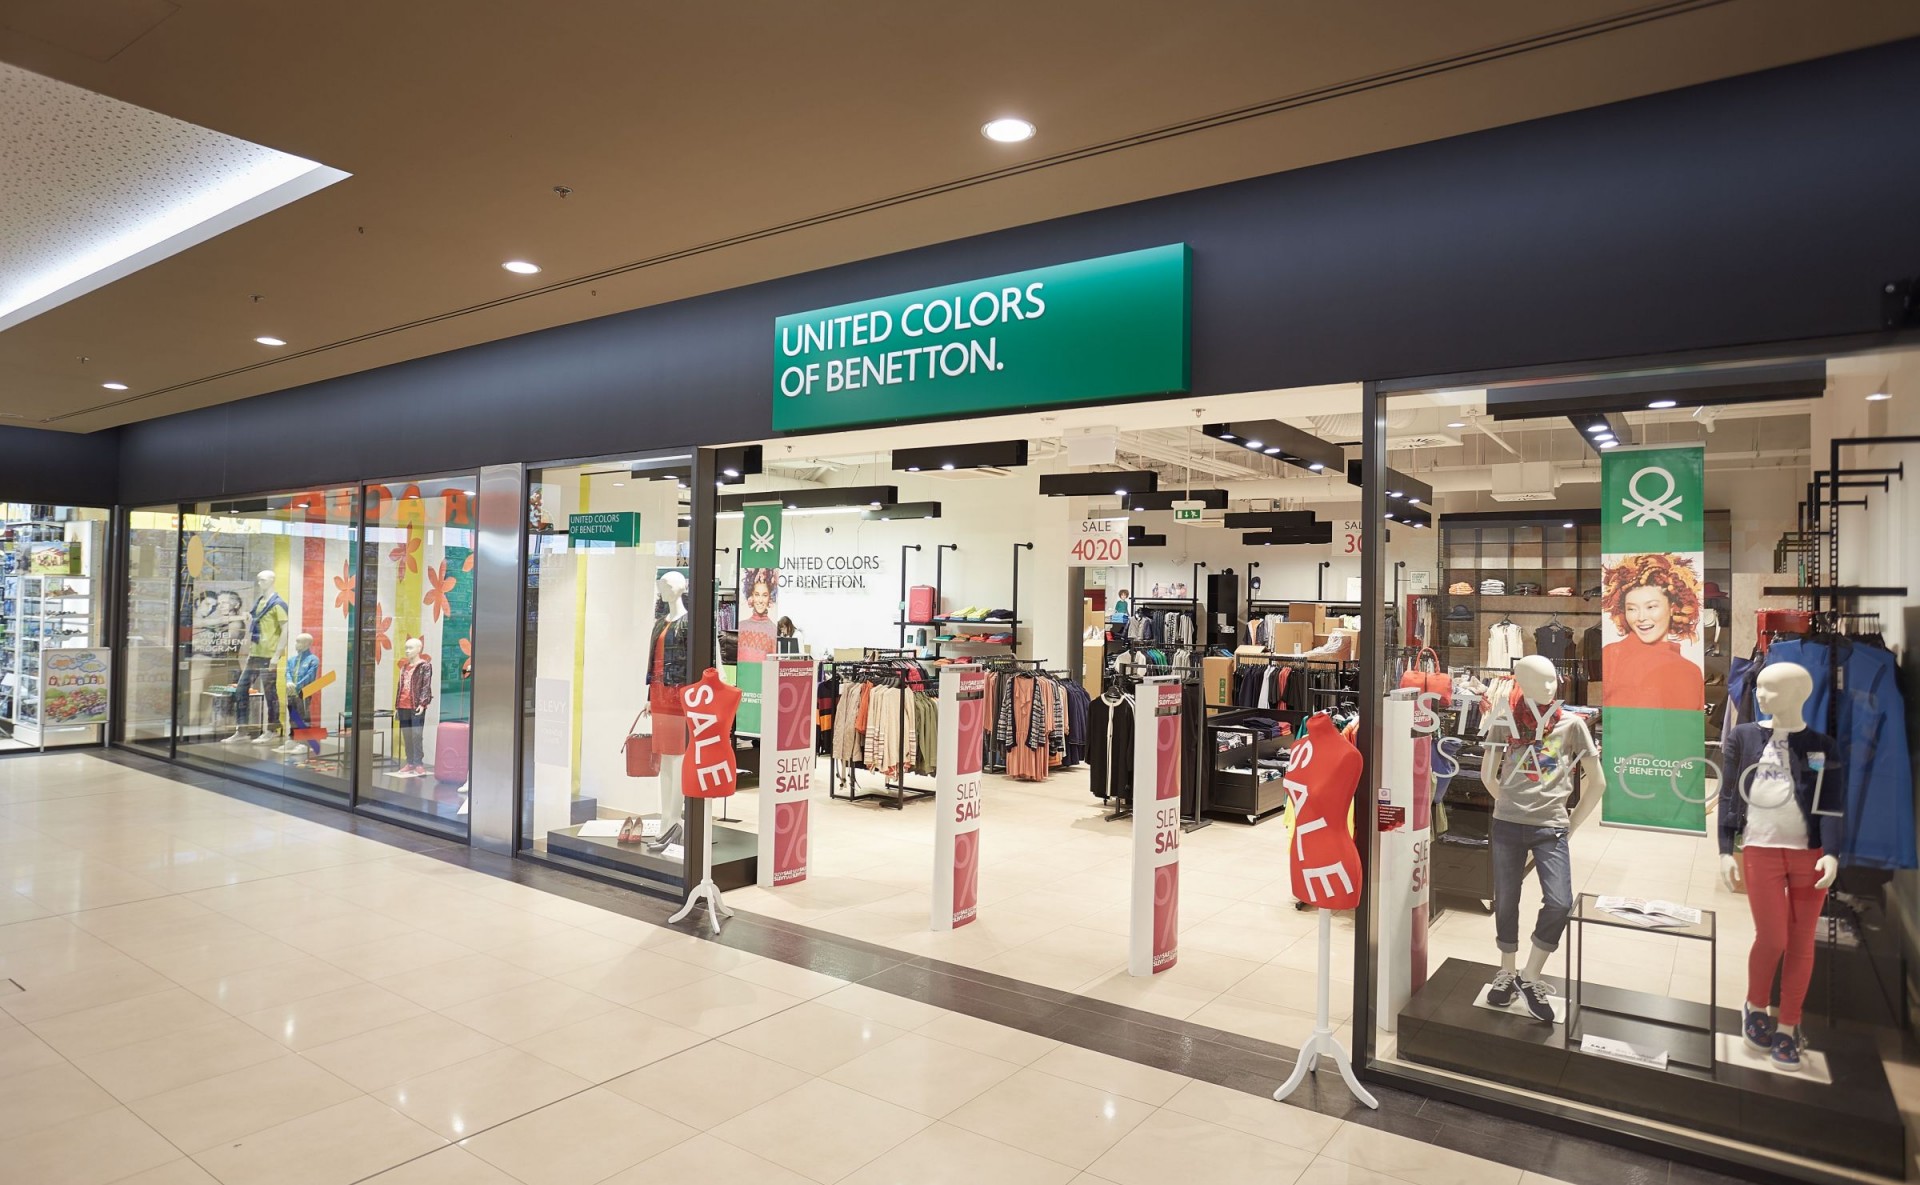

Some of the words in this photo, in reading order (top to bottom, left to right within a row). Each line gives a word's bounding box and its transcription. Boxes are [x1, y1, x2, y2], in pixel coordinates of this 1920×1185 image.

[782, 310, 893, 357] UNITED
[900, 282, 1046, 338] COLORS
[780, 363, 820, 398] OF
[826, 337, 1004, 393] BENETTON.
[570, 515, 593, 524] UNITED
[594, 514, 620, 523] COLORS
[1082, 521, 1112, 532] SALE
[1344, 521, 1362, 530] SAL
[570, 526, 578, 534] OF
[580, 525, 614, 534] BENETTON.
[779, 557, 823, 570] UNITED
[826, 556, 879, 570] COLORS
[778, 575, 793, 588] OF
[796, 575, 866, 589] BENETTON.
[1412, 692, 1565, 741] STAY
[684, 684, 733, 792] SALE
[777, 756, 810, 774] SLEVY
[1614, 757, 1650, 767] UNITED
[1652, 759, 1693, 770] COLORS
[1614, 765, 1627, 774] OF
[775, 773, 810, 793] SALE
[1433, 737, 1587, 790] STAY
[1619, 753, 1843, 816] COOL
[1283, 740, 1354, 902] SALE
